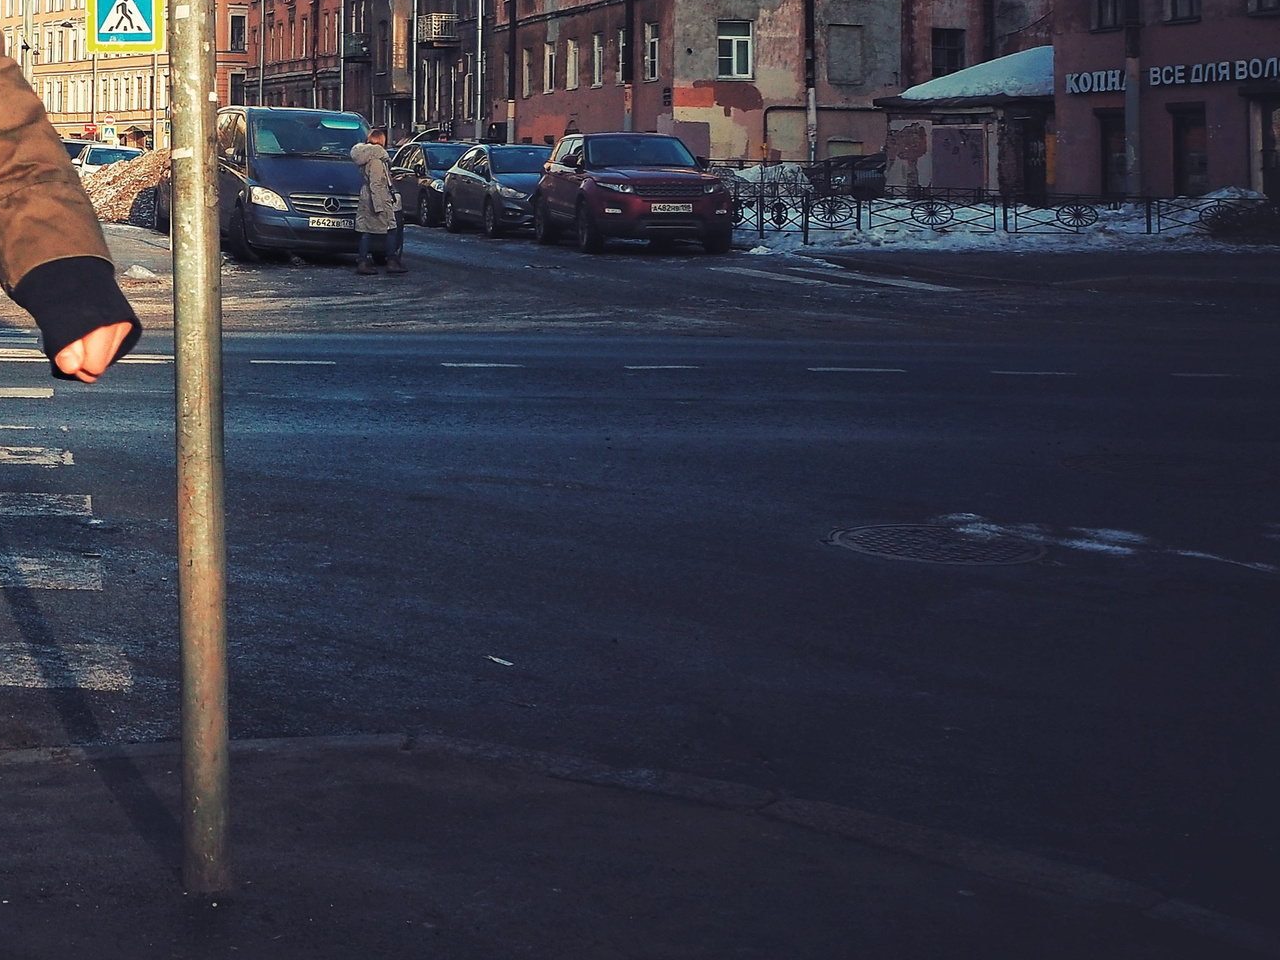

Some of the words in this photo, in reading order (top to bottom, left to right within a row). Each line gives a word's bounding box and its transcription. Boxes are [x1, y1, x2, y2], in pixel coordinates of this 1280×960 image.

[1149, 65, 1185, 86] ВСЕ
[1190, 61, 1230, 84] ДЛЯ
[1235, 57, 1280, 80] ВОЛ
